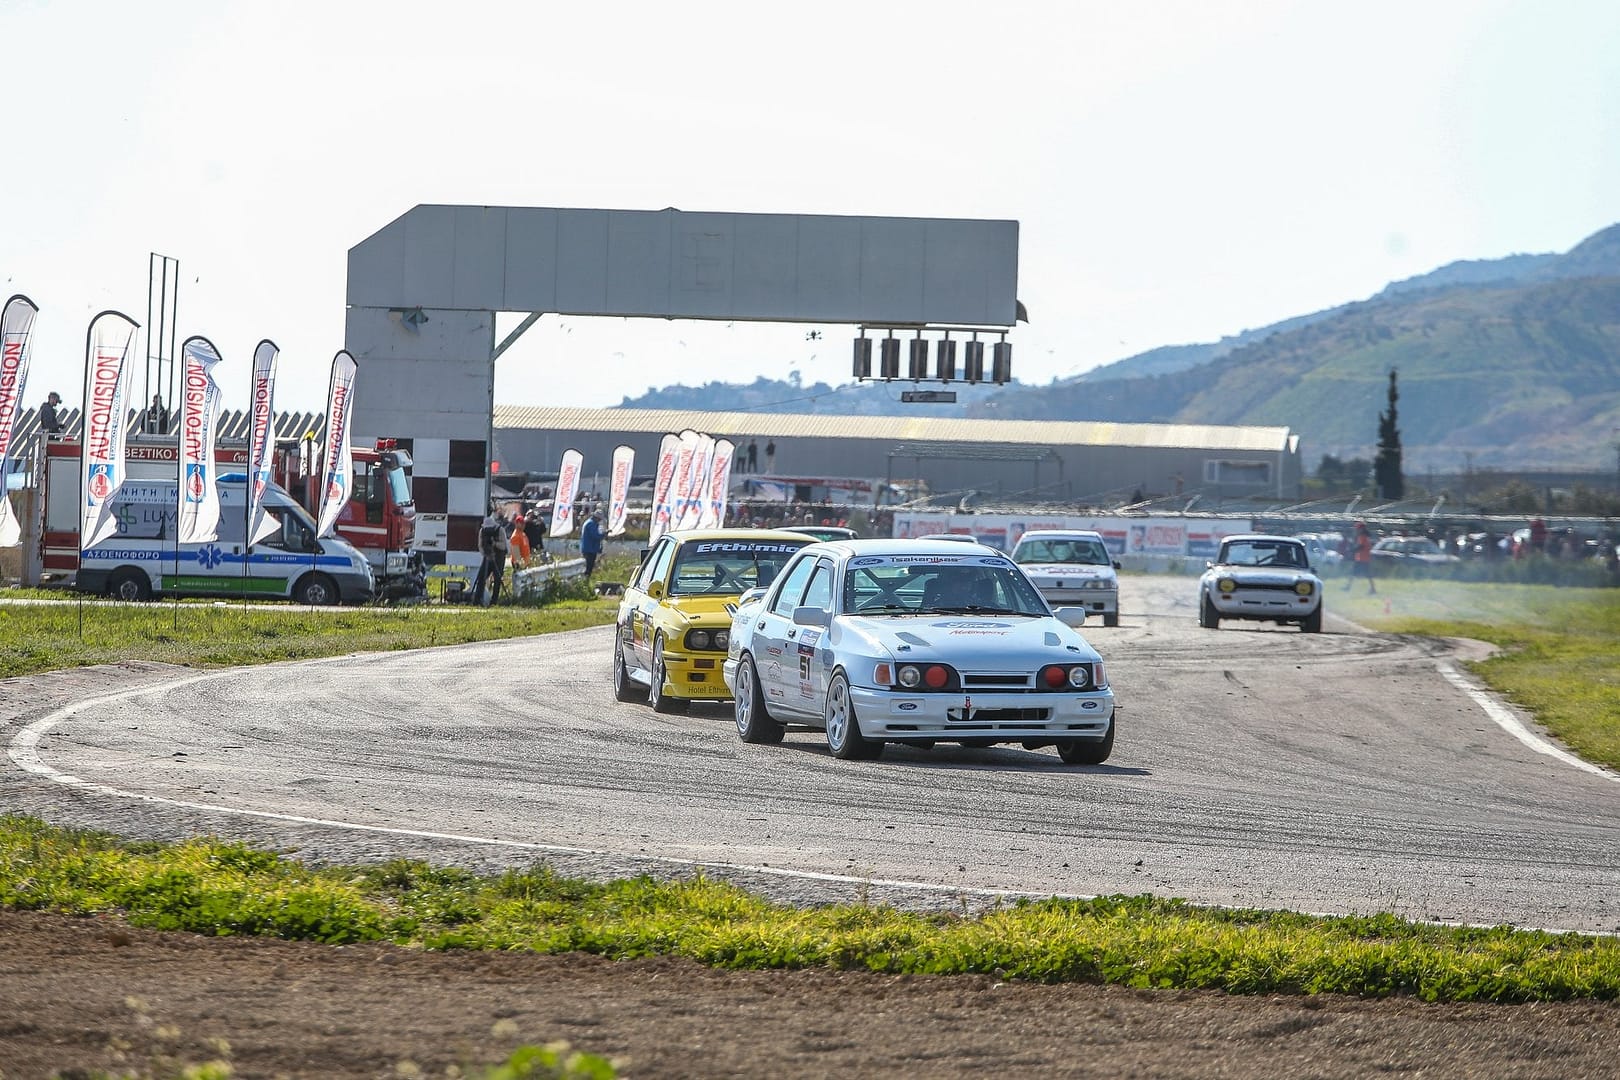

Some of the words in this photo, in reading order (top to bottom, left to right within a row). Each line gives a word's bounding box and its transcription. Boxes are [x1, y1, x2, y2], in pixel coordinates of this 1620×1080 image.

[89, 356, 119, 460] AUTOVISION
[186, 364, 208, 461] AUTOVISION
[253, 377, 269, 466] AUTOVISION
[330, 386, 347, 472] AUTOVISION
[125, 448, 172, 460] ΒΕΣΤΙΚΟ
[87, 551, 160, 560] ΑΣΘΕΝΟΦΟΡΟ
[857, 558, 882, 566] Ford
[983, 558, 1005, 566] Ford
[799, 655, 811, 681] 51
[688, 685, 706, 694] Hotel
[708, 685, 731, 694] Efthim
